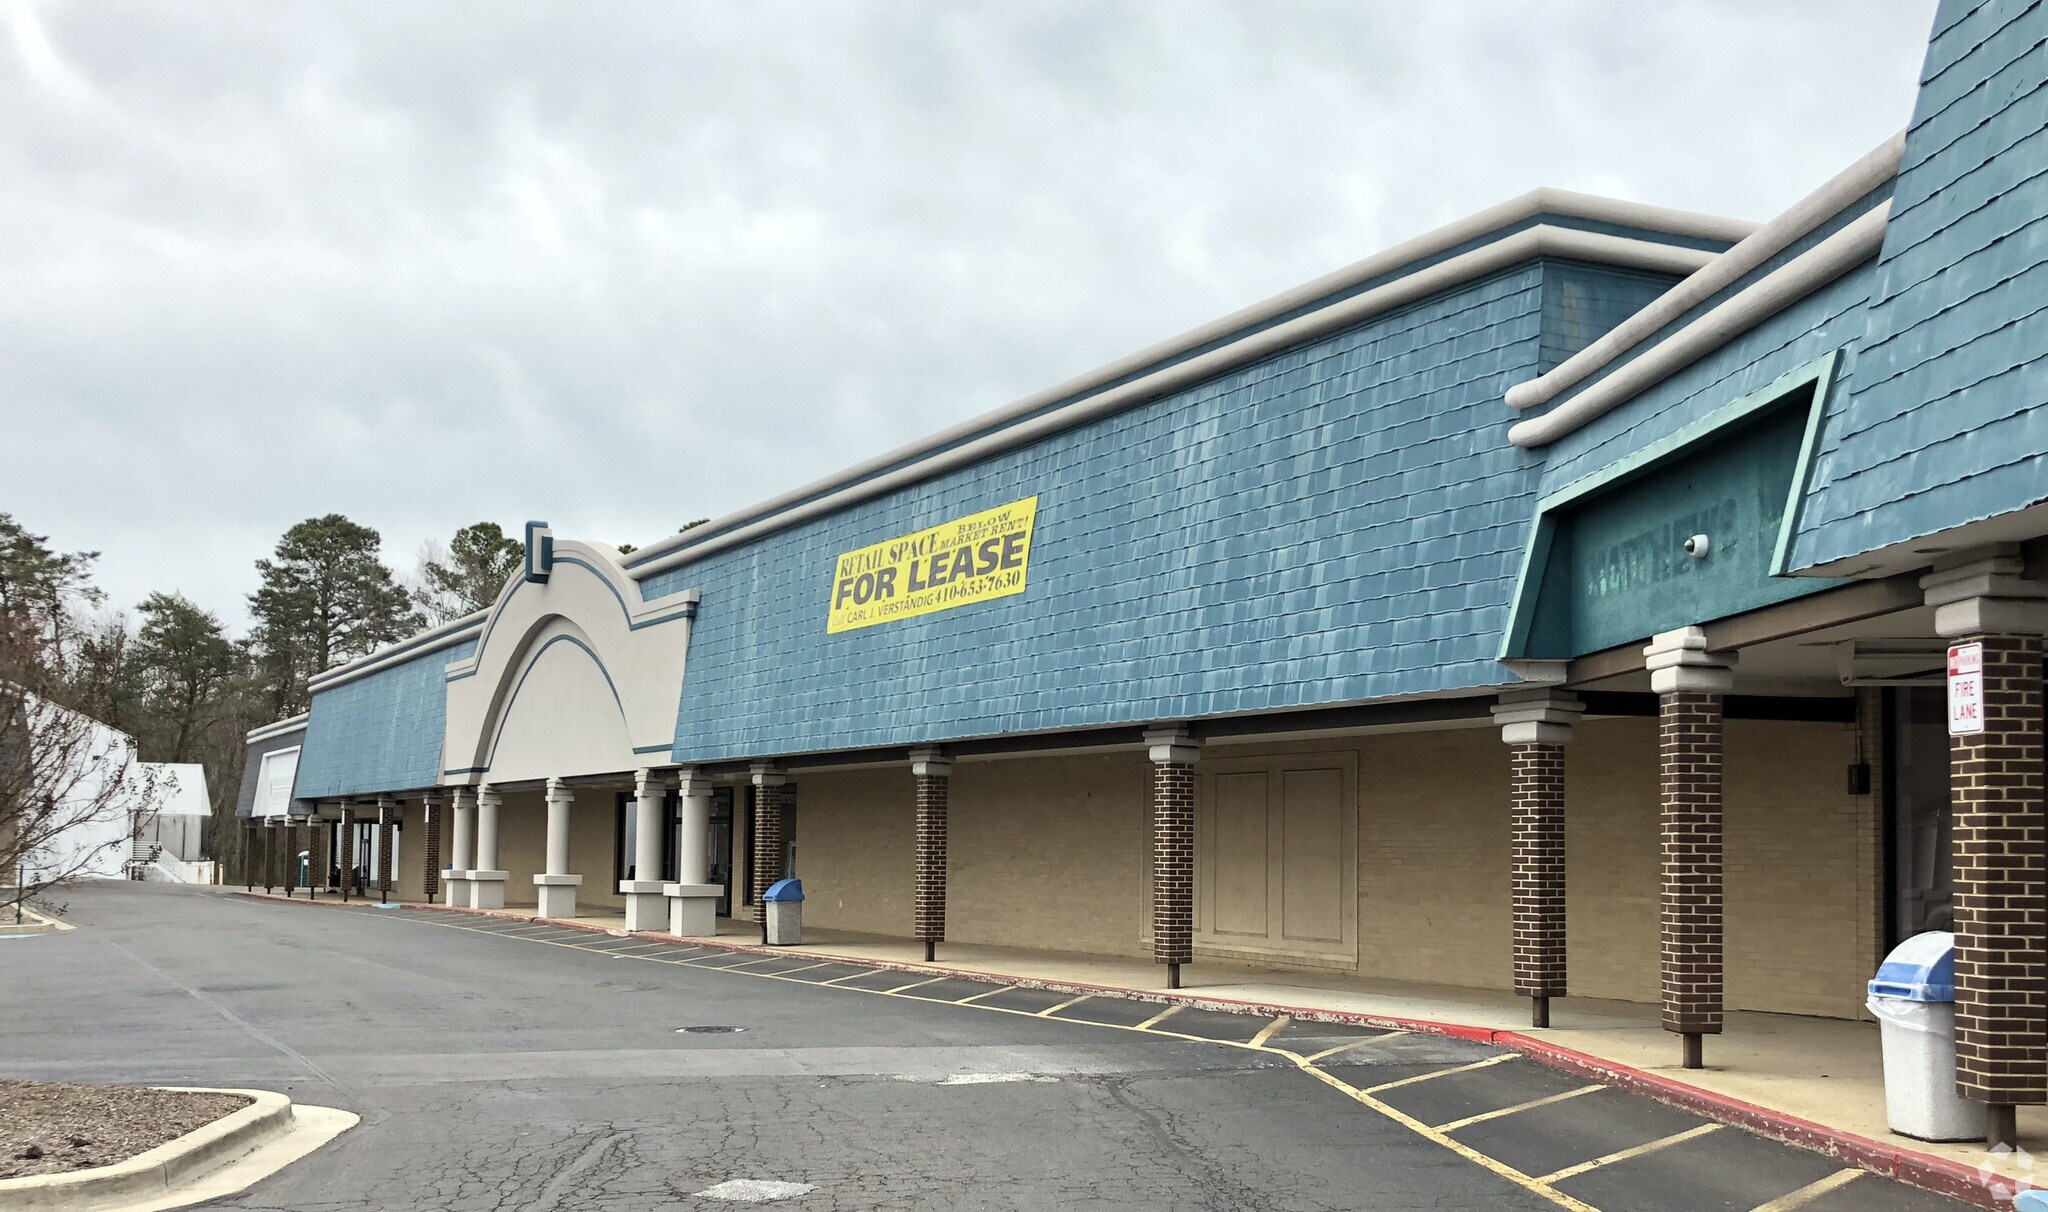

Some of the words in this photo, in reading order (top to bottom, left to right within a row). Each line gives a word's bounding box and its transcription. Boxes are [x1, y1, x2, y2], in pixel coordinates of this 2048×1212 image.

[939, 528, 989, 550] MARKET
[990, 516, 1028, 535] RENT!
[957, 510, 1011, 535] BELOW
[835, 567, 897, 610] FOR
[908, 531, 1026, 593] LEASE
[840, 548, 885, 578] RETAIL
[888, 532, 940, 564] SPACE
[847, 609, 867, 623] CARL
[869, 608, 875, 619] J.
[878, 593, 933, 616] VERSTANDIG
[935, 571, 1021, 605] 410-653-7630
[1955, 681, 1974, 697] FIRE
[1954, 703, 1977, 720] LANE
